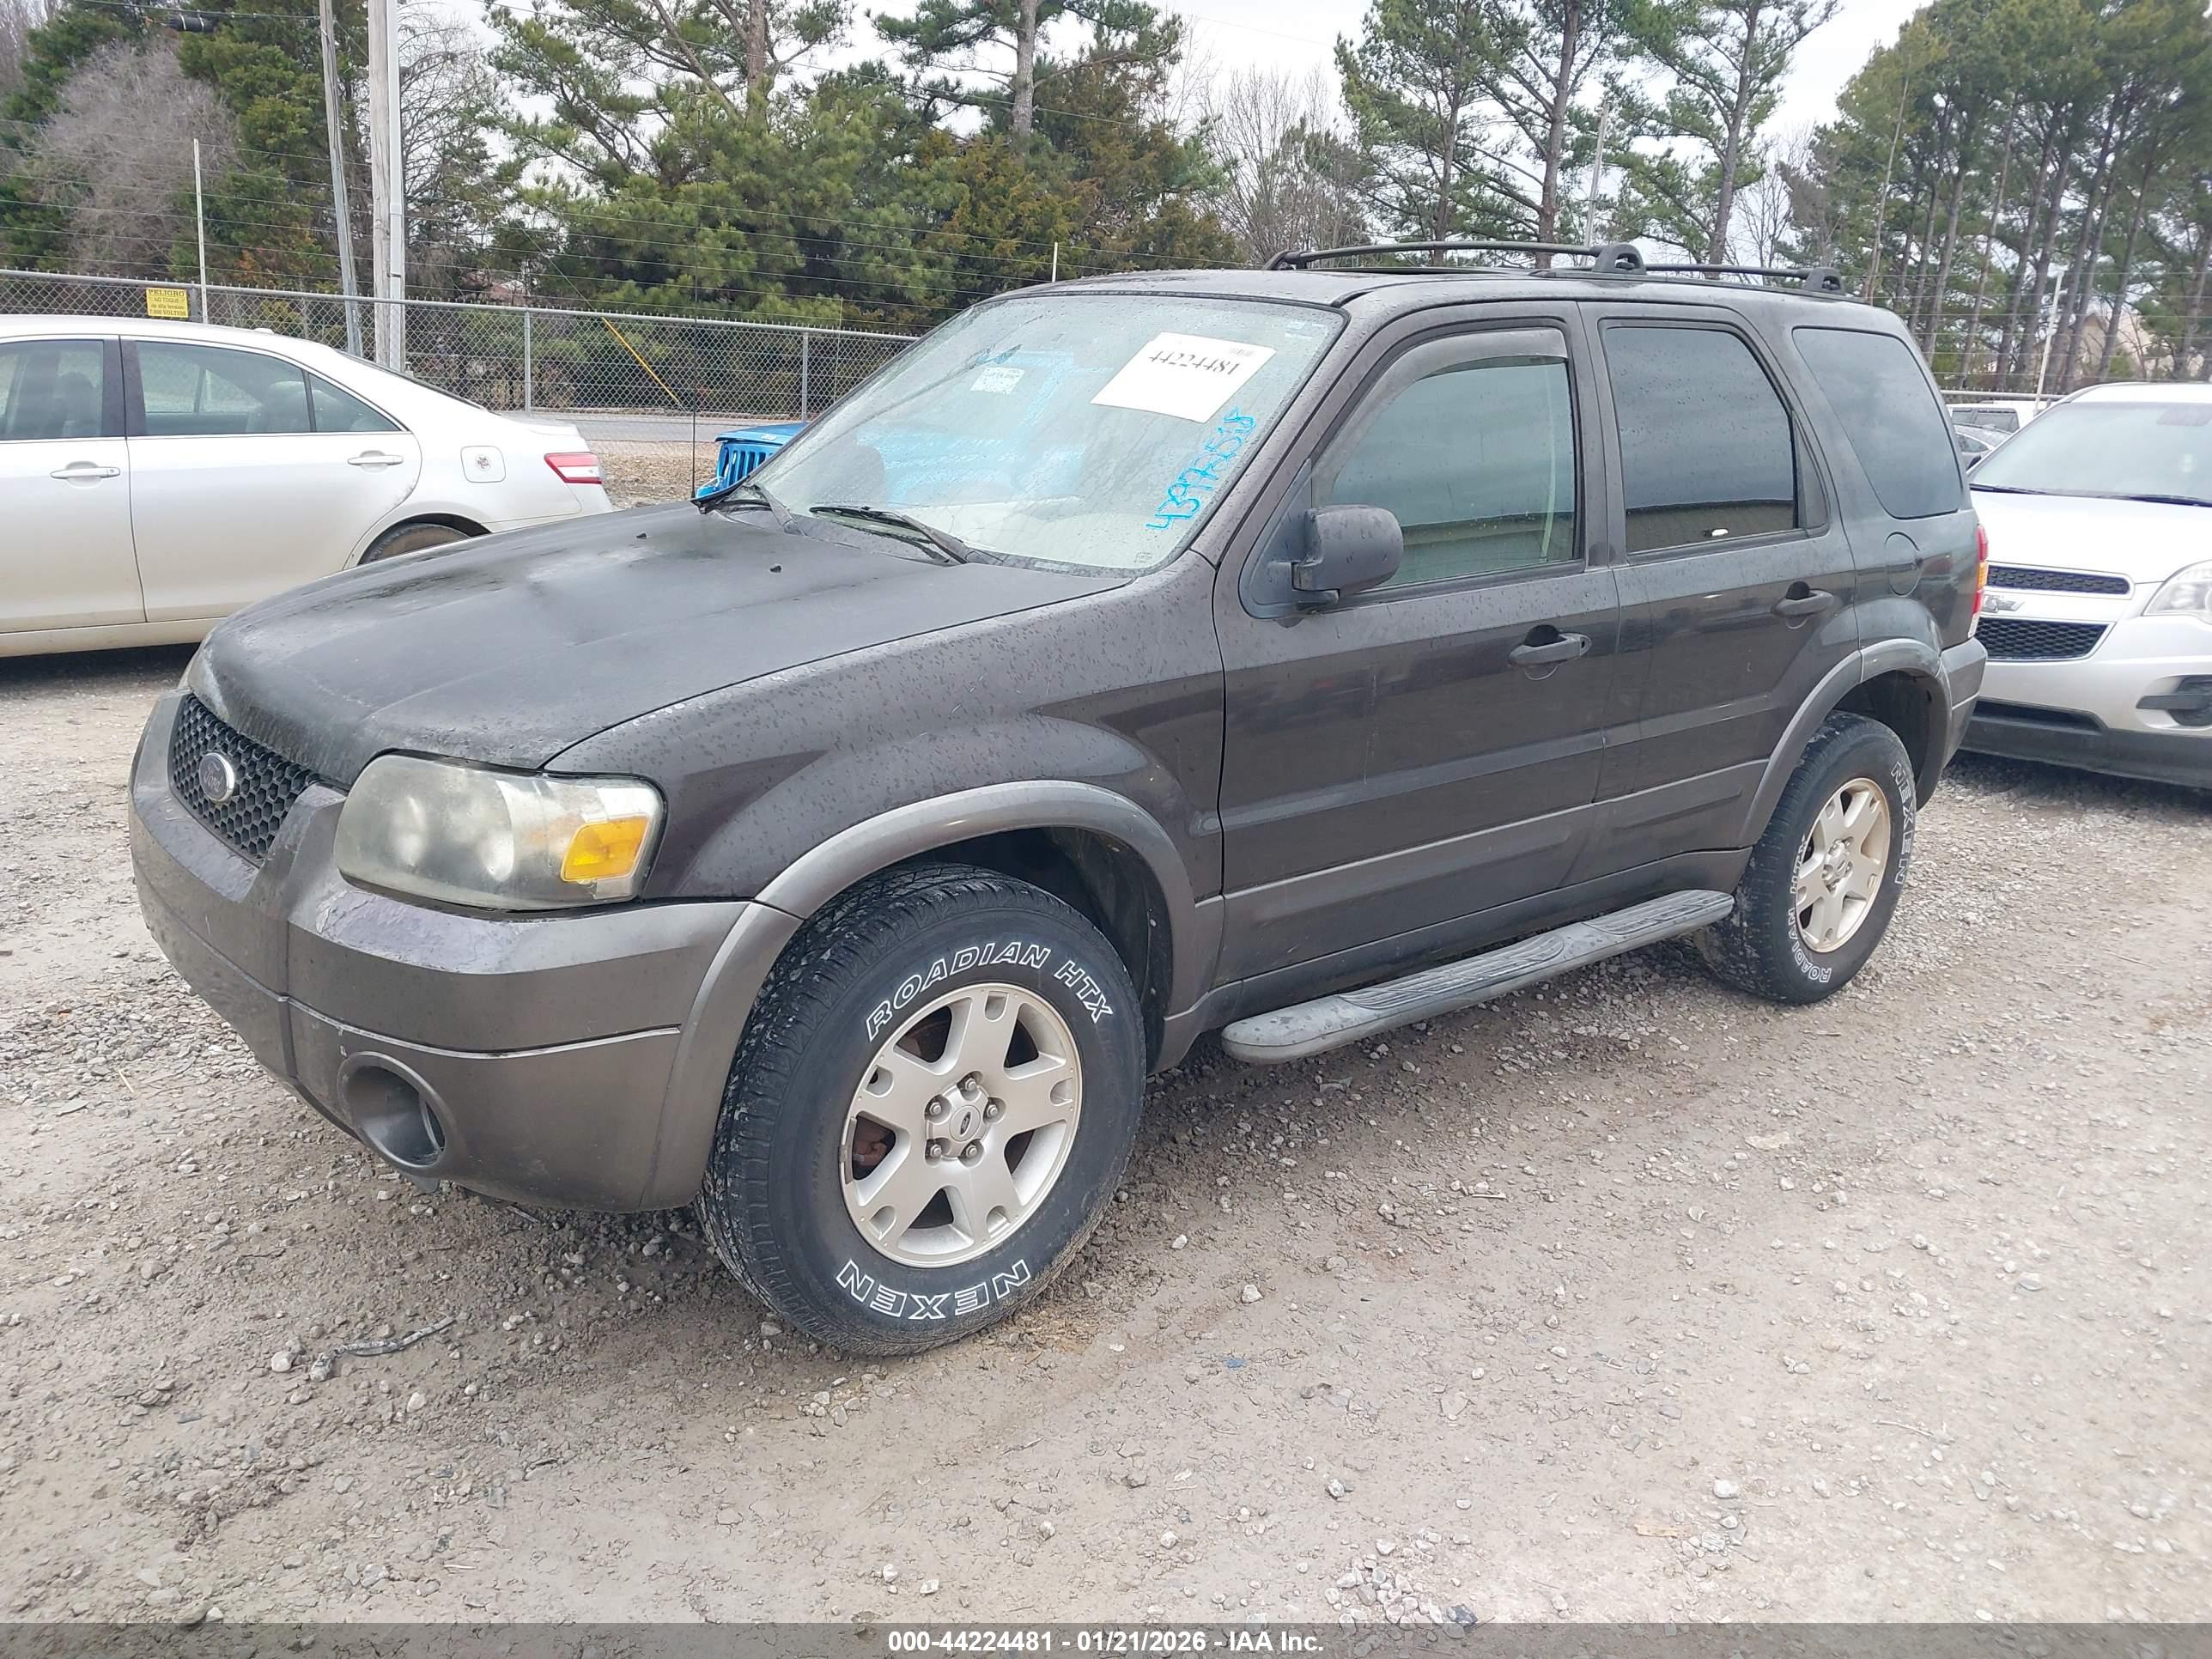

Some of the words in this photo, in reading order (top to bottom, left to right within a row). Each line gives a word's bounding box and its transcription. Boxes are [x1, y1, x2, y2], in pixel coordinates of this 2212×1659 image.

[1148, 350, 1241, 375] 44224481
[1891, 762, 1915, 884] NEXEN
[865, 941, 1052, 1042] ROADIAN
[1054, 960, 1114, 1024] HTX
[836, 1258, 1031, 1320] NEXEN
